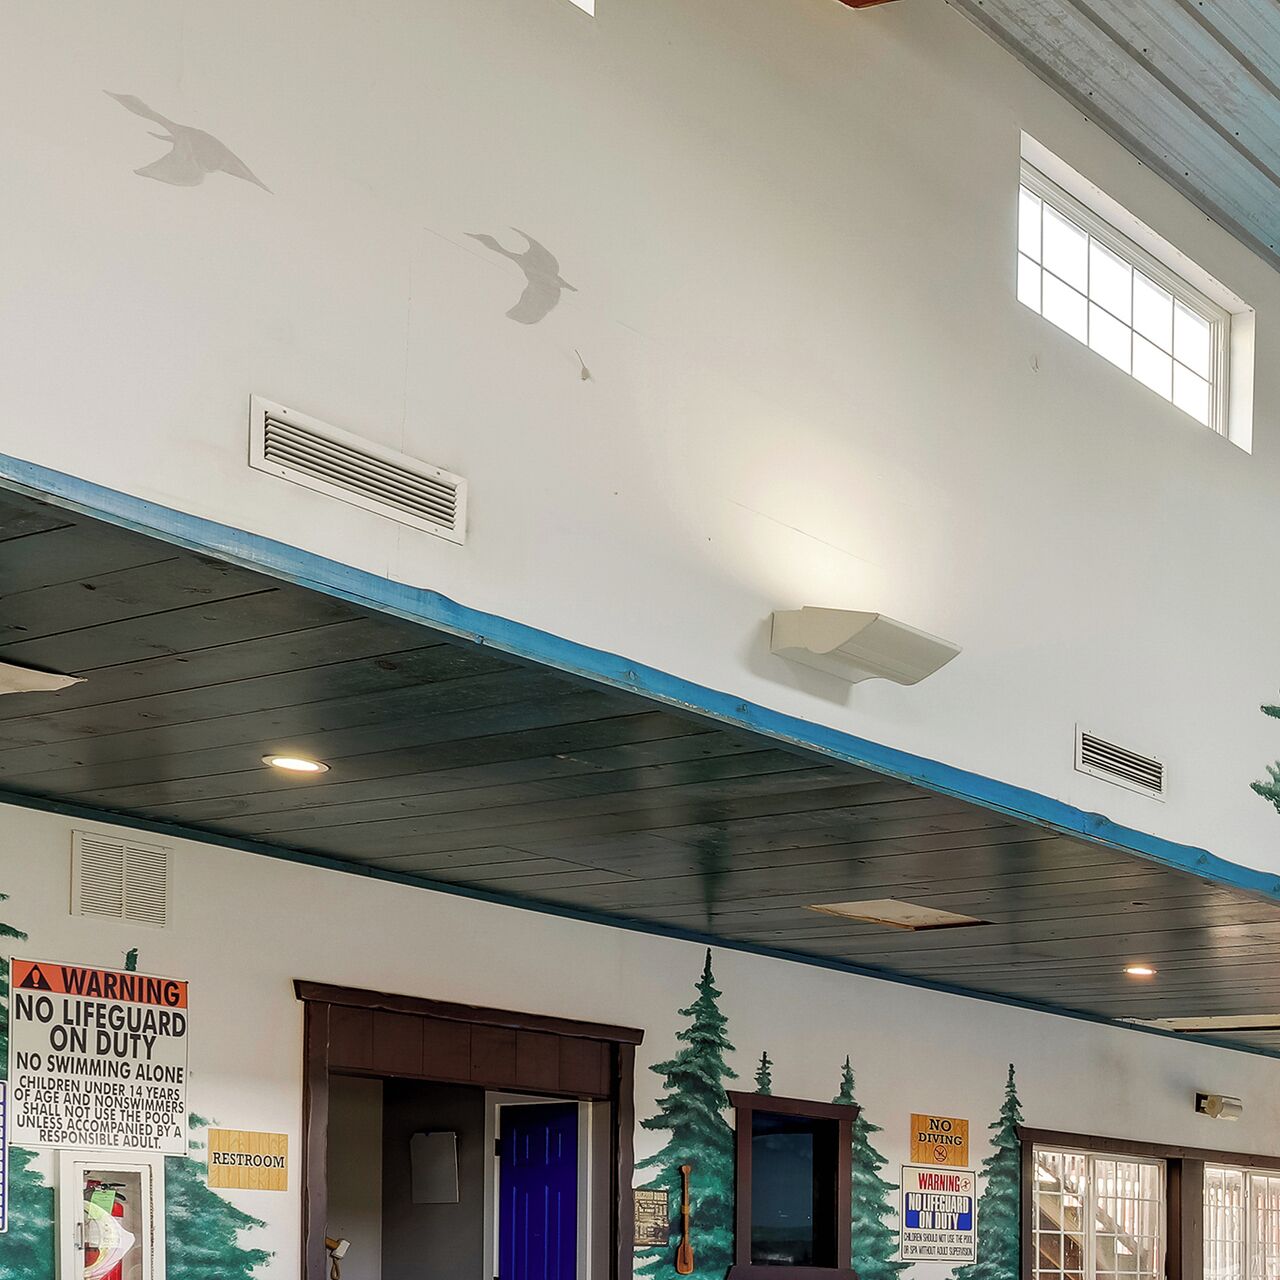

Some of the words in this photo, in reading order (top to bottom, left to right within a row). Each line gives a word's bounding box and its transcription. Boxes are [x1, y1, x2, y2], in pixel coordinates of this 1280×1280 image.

[61, 967, 180, 1006] WARNING
[15, 993, 54, 1023] NO
[63, 999, 186, 1037] LIFEGUARD
[50, 1024, 87, 1053] ON
[96, 1030, 157, 1060] DUTY
[16, 1051, 41, 1071] NO
[47, 1055, 131, 1079] SWIMMING
[135, 1064, 184, 1084] ALONE
[19, 1075, 81, 1093] CHILDREN
[85, 1081, 125, 1097] UNDER
[130, 1085, 142, 1098] 14
[146, 1087, 180, 1101] YEARS
[14, 1088, 31, 1101] OF
[34, 1090, 59, 1104] AGE
[63, 1092, 90, 1106] AND
[94, 1095, 184, 1114] NONSWIMMERS
[23, 1101, 60, 1117] SHALL
[64, 1105, 91, 1119] NOT
[94, 1108, 116, 1121] USE
[120, 1110, 141, 1123] THE
[145, 1112, 176, 1126] POOL
[17, 1114, 63, 1130] UNLESS
[67, 1119, 153, 1136] ACCOMPANIED
[157, 1124, 171, 1138] BY
[174, 1126, 182, 1138] A
[929, 1118, 952, 1132] NO
[39, 1129, 119, 1147] RESPONSIBLE
[122, 1135, 162, 1149] ADULT.
[918, 1132, 963, 1146] DIVING
[213, 1152, 285, 1168] RESTROOM
[918, 1172, 960, 1192] WARNING
[908, 1192, 922, 1212] NO
[923, 1193, 969, 1214] LIFEGUARD
[919, 1211, 932, 1230] ON
[936, 1211, 960, 1230] DUTY
[904, 1232, 922, 1242] CHILDREN
[923, 1232, 938, 1243] SHOULD
[939, 1233, 947, 1243] NOT
[955, 1234, 963, 1244] THE
[963, 1234, 973, 1244] POOL
[917, 1245, 936, 1255] WITHOUT
[937, 1246, 948, 1255] ADULT
